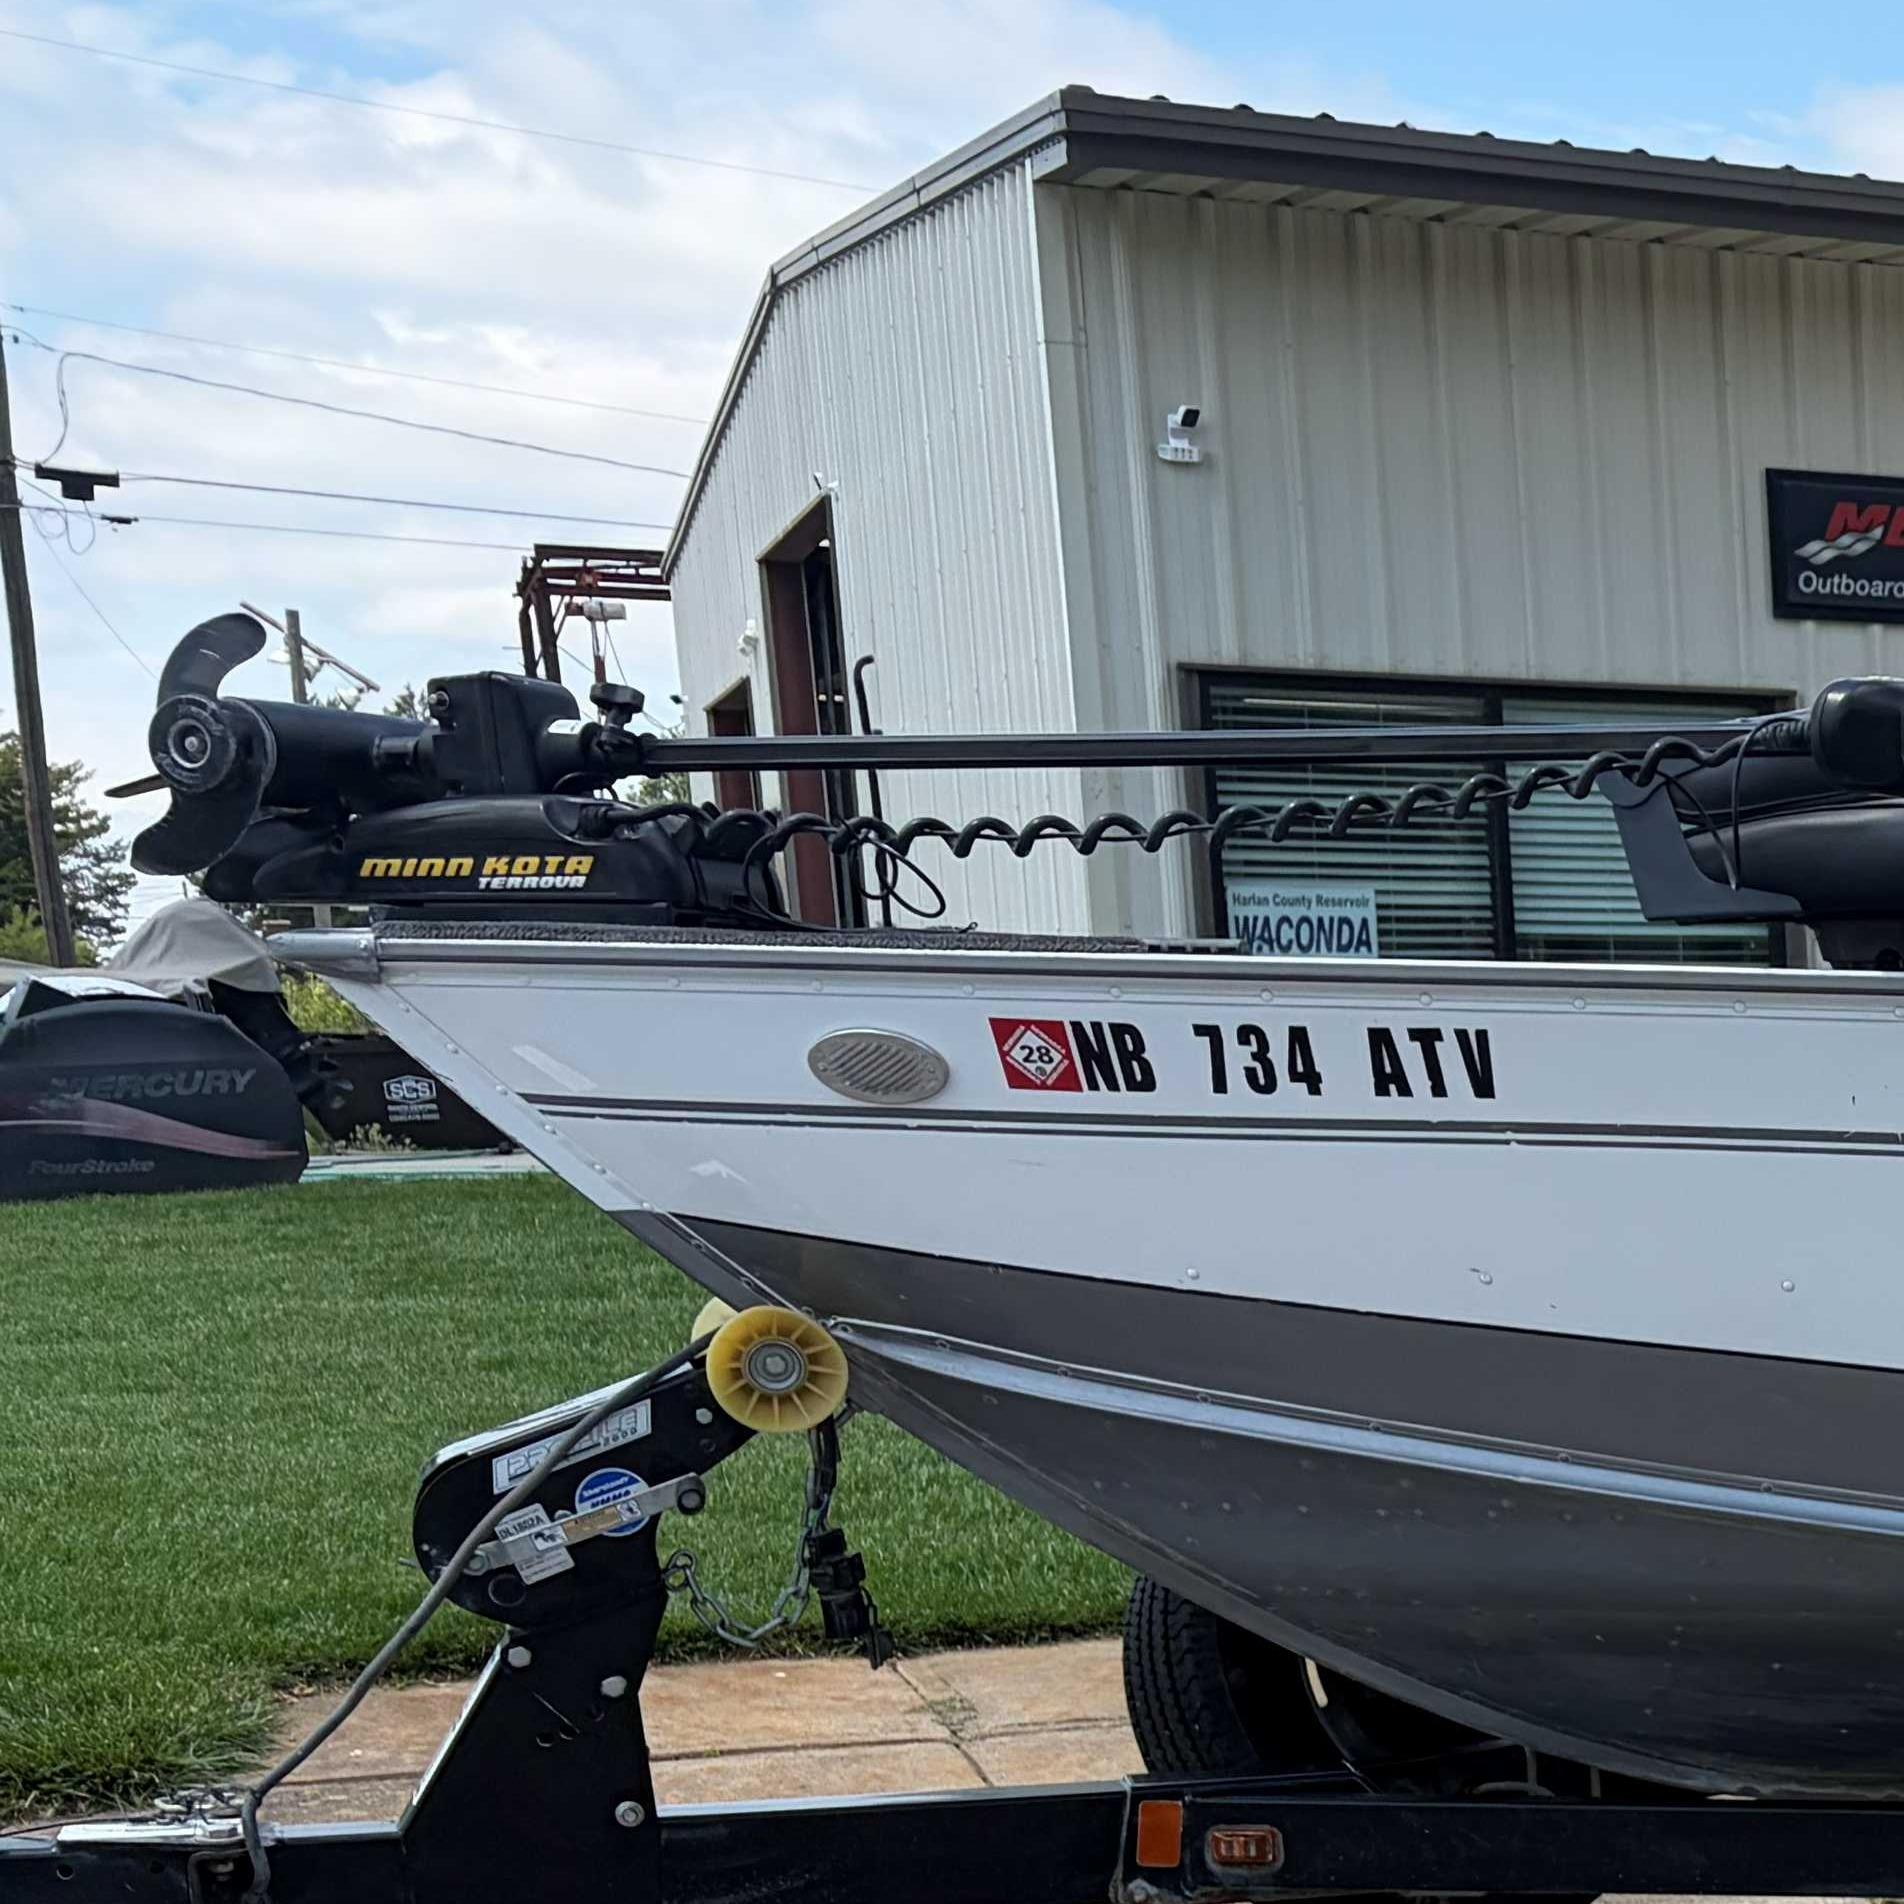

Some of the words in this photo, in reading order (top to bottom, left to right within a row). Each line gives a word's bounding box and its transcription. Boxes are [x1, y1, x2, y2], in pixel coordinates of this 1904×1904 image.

[359, 857, 475, 878] MINN
[482, 854, 595, 876] KOTA
[478, 874, 588, 890] TERROVA
[1232, 892, 1270, 907] Harlan
[1272, 892, 1313, 910] County
[1315, 893, 1371, 909] Reservoir
[1233, 914, 1373, 954] WACONDA
[1019, 1044, 1054, 1064] 28
[1069, 1020, 1157, 1093] NB
[1192, 1023, 1323, 1097] 734
[1367, 1026, 1496, 1100] ATV
[50, 1068, 257, 1100] MERCURY
[28, 1158, 156, 1176] FourStroke
